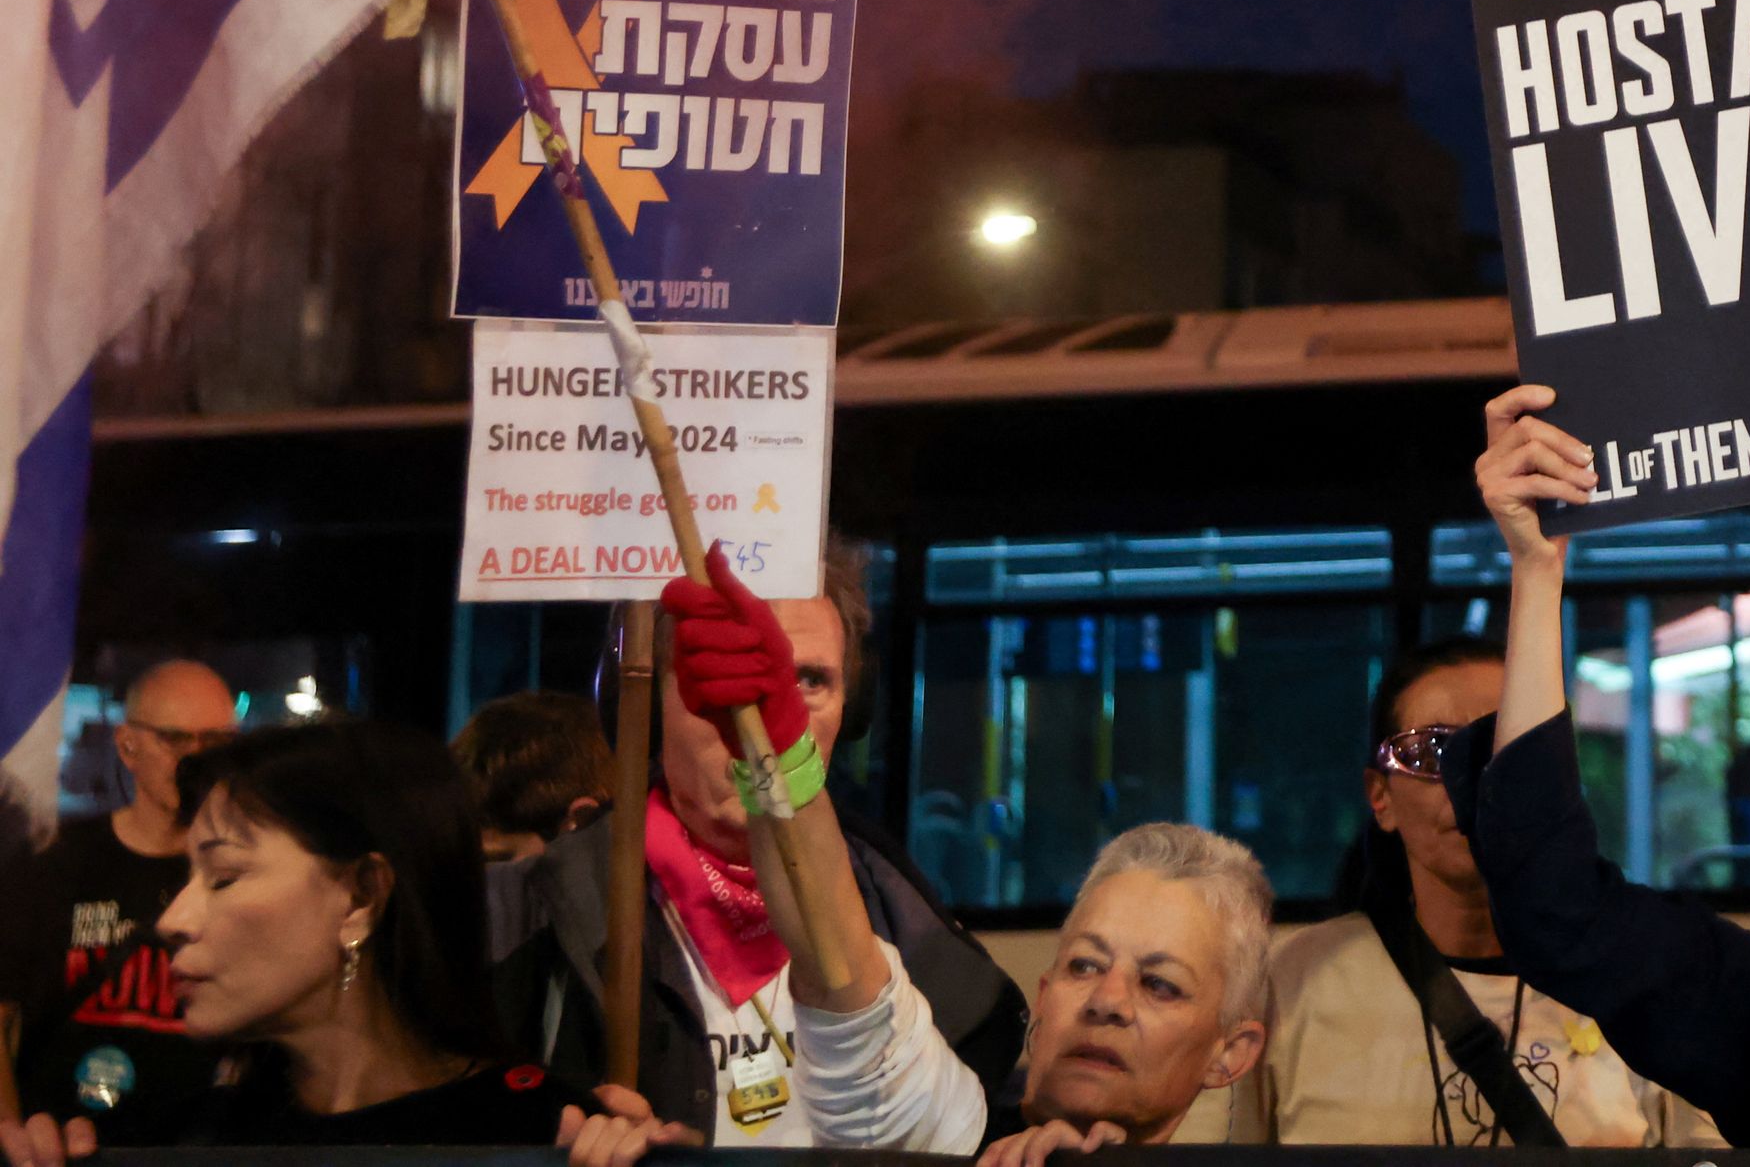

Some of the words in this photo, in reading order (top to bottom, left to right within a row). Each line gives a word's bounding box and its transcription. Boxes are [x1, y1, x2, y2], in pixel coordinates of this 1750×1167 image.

[651, 368, 809, 400] STRIKERS
[488, 423, 566, 451] Since
[577, 424, 646, 458] May
[1557, 441, 1637, 510] LL
[1628, 448, 1655, 482] OF
[484, 487, 528, 511] The
[535, 487, 631, 516] struggle
[706, 493, 737, 510] on
[478, 547, 501, 574] A
[511, 546, 585, 574] DEAL
[596, 545, 682, 574] NOW
